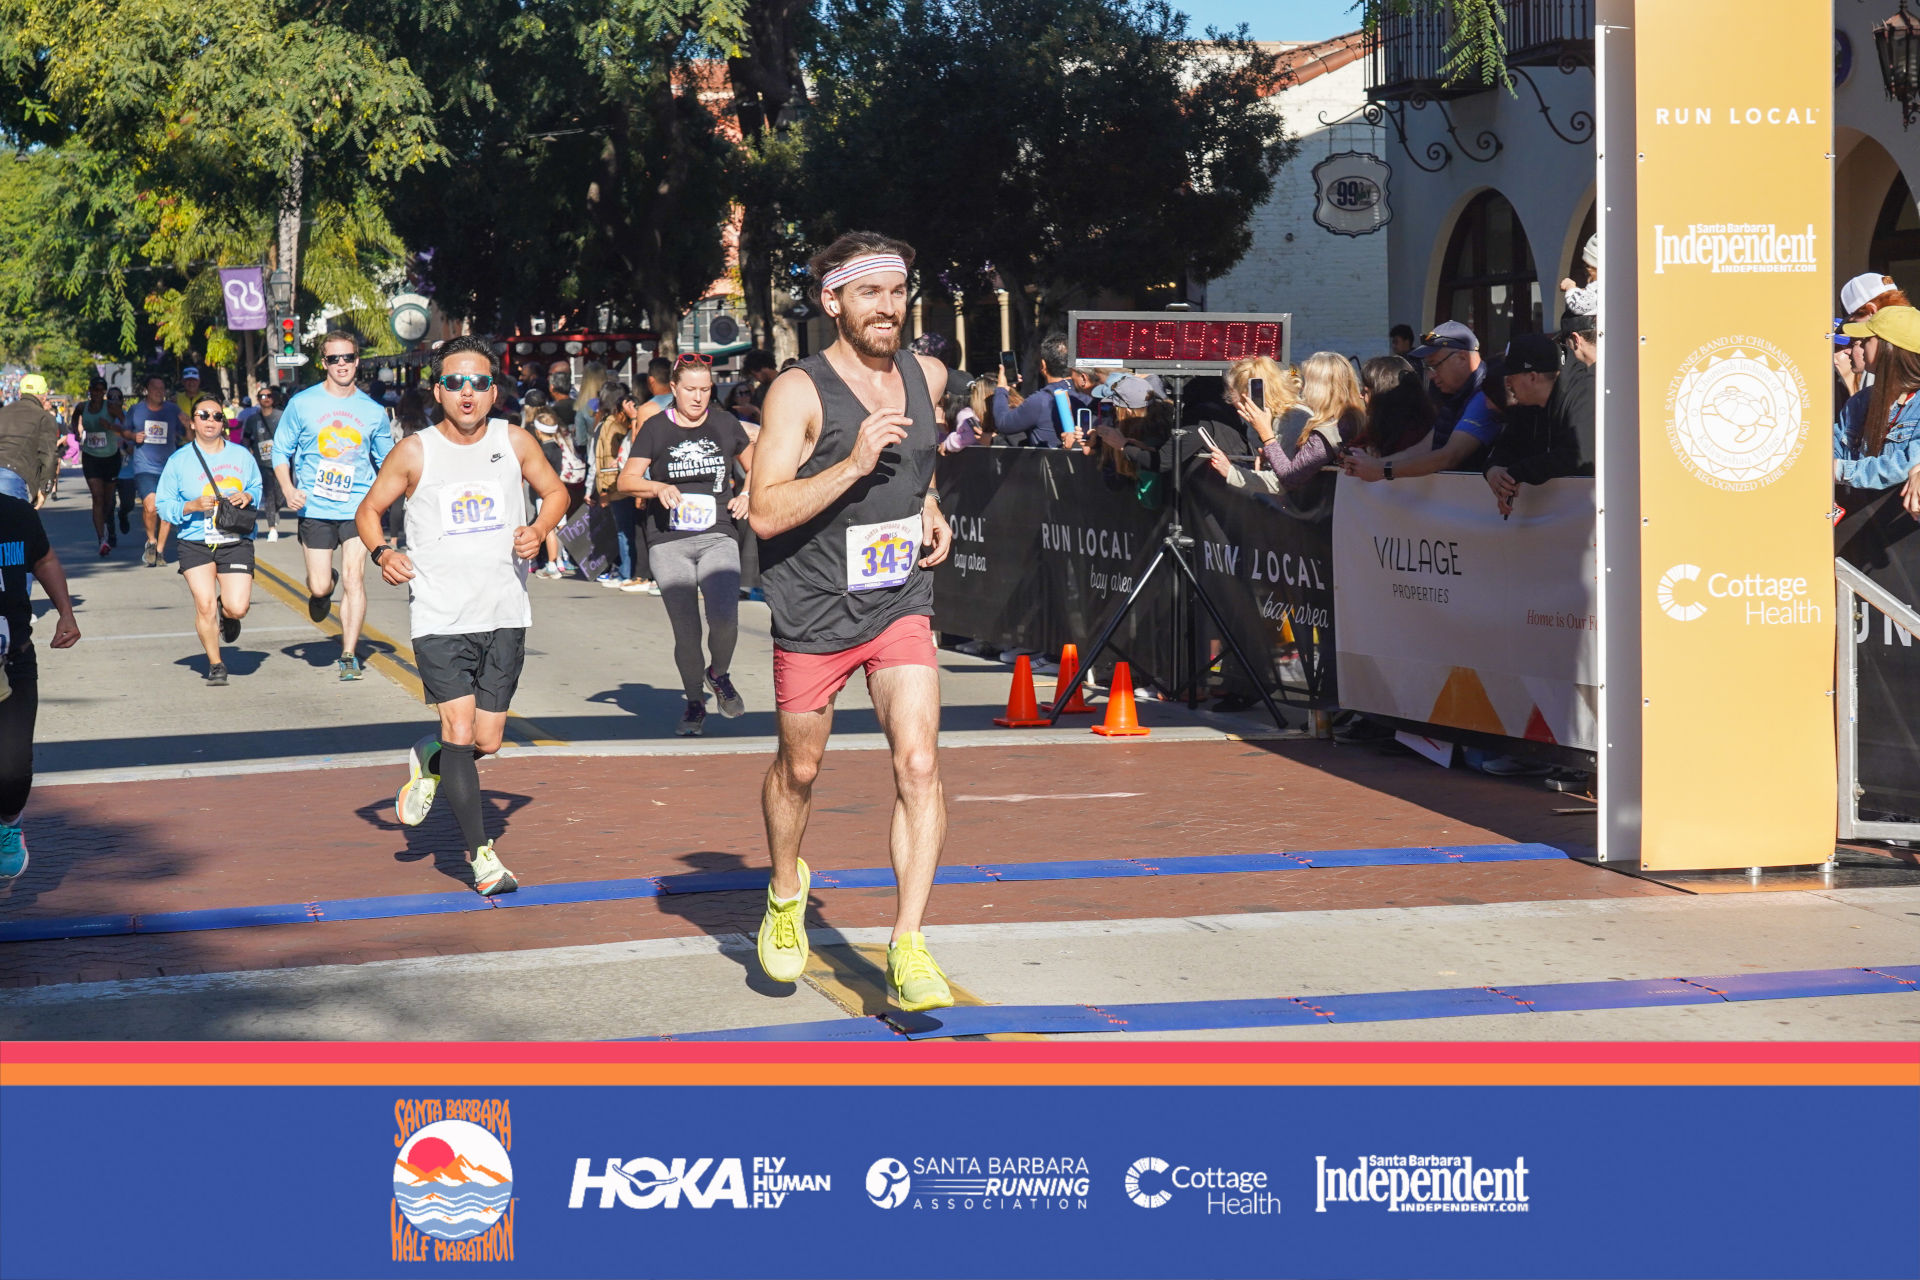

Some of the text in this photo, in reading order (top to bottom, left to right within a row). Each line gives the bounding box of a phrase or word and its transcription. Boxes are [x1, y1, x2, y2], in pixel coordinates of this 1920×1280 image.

[1656, 107, 1816, 125] RUN LOCAL
[1337, 181, 1358, 206] 99
[1696, 223, 1767, 234] Santa Barbara
[1654, 223, 1817, 274] Independent
[1721, 264, 1817, 273] INDEPENDENT.COM
[1664, 375, 1683, 411] SANTA
[1699, 336, 1729, 355] BAND
[1730, 335, 1744, 345] OF
[1745, 335, 1793, 367] CHUMASH
[1790, 365, 1811, 409] INDIANS
[667, 456, 725, 471] SINGLETRACK
[1664, 419, 1697, 473] FEDERALLY
[1694, 469, 1758, 492] RECOGNIZED
[1758, 465, 1785, 488] TRIBE
[1783, 442, 1805, 470] SINCE
[318, 469, 351, 489] 3949
[668, 466, 717, 479] STAMPEDE
[451, 496, 496, 525] 602
[672, 507, 713, 525] 1637
[943, 514, 985, 542] OCAL
[1042, 523, 1132, 560] RUN LOCAL
[861, 541, 914, 577] 343
[1203, 541, 1326, 591] RUN LOCAL
[1374, 536, 1462, 576] VILLAGE
[1090, 565, 1133, 599] bay area
[1392, 584, 1449, 604] PROPERTIES
[1707, 572, 1807, 601] Cottage
[1262, 591, 1329, 631] bay area
[1527, 609, 1554, 628] Home
[1556, 611, 1565, 627] is
[1566, 613, 1586, 630] Our
[1746, 600, 1821, 625] Health
